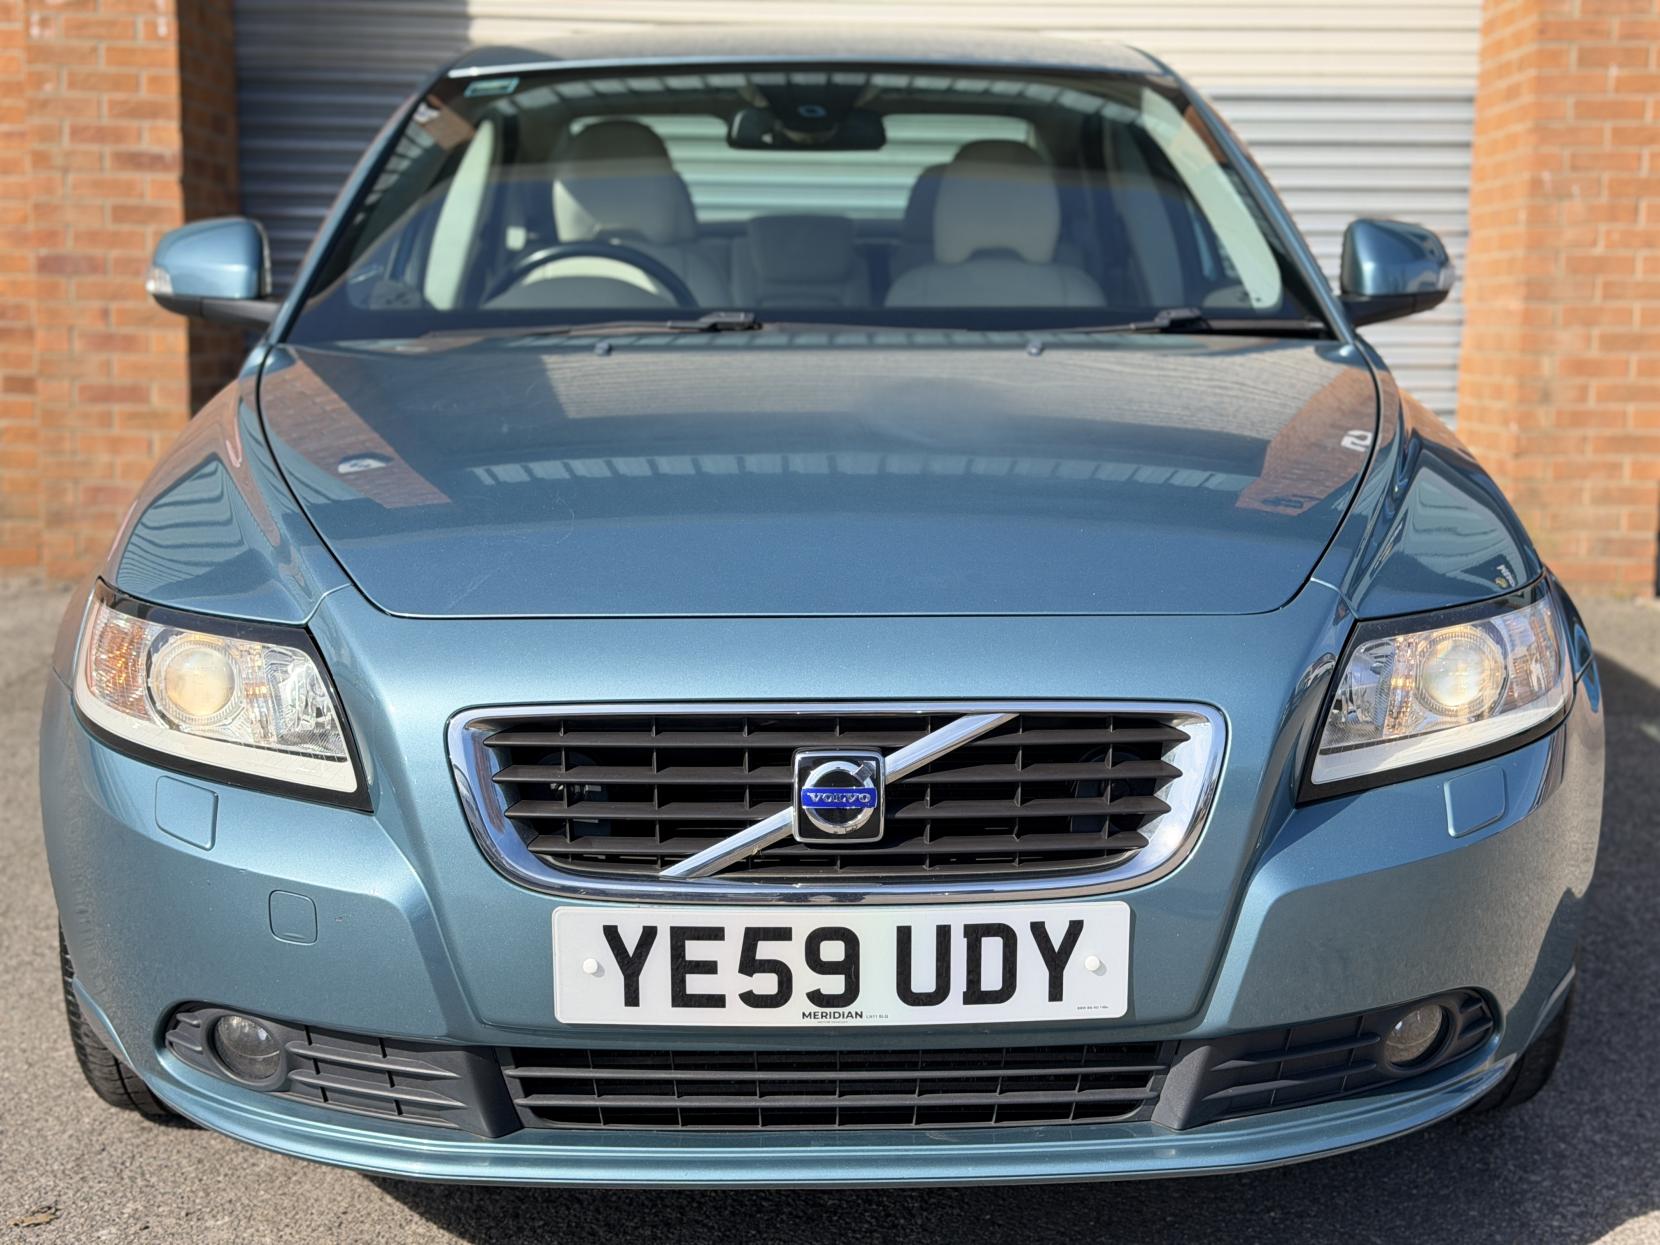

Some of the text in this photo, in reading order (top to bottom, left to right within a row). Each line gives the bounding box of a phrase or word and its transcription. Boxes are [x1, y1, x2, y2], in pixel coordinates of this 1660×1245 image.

[806, 792, 871, 803] VOLVO
[602, 919, 1084, 1009] YE59 UDY
[802, 1011, 863, 1020] MERIDIAN
